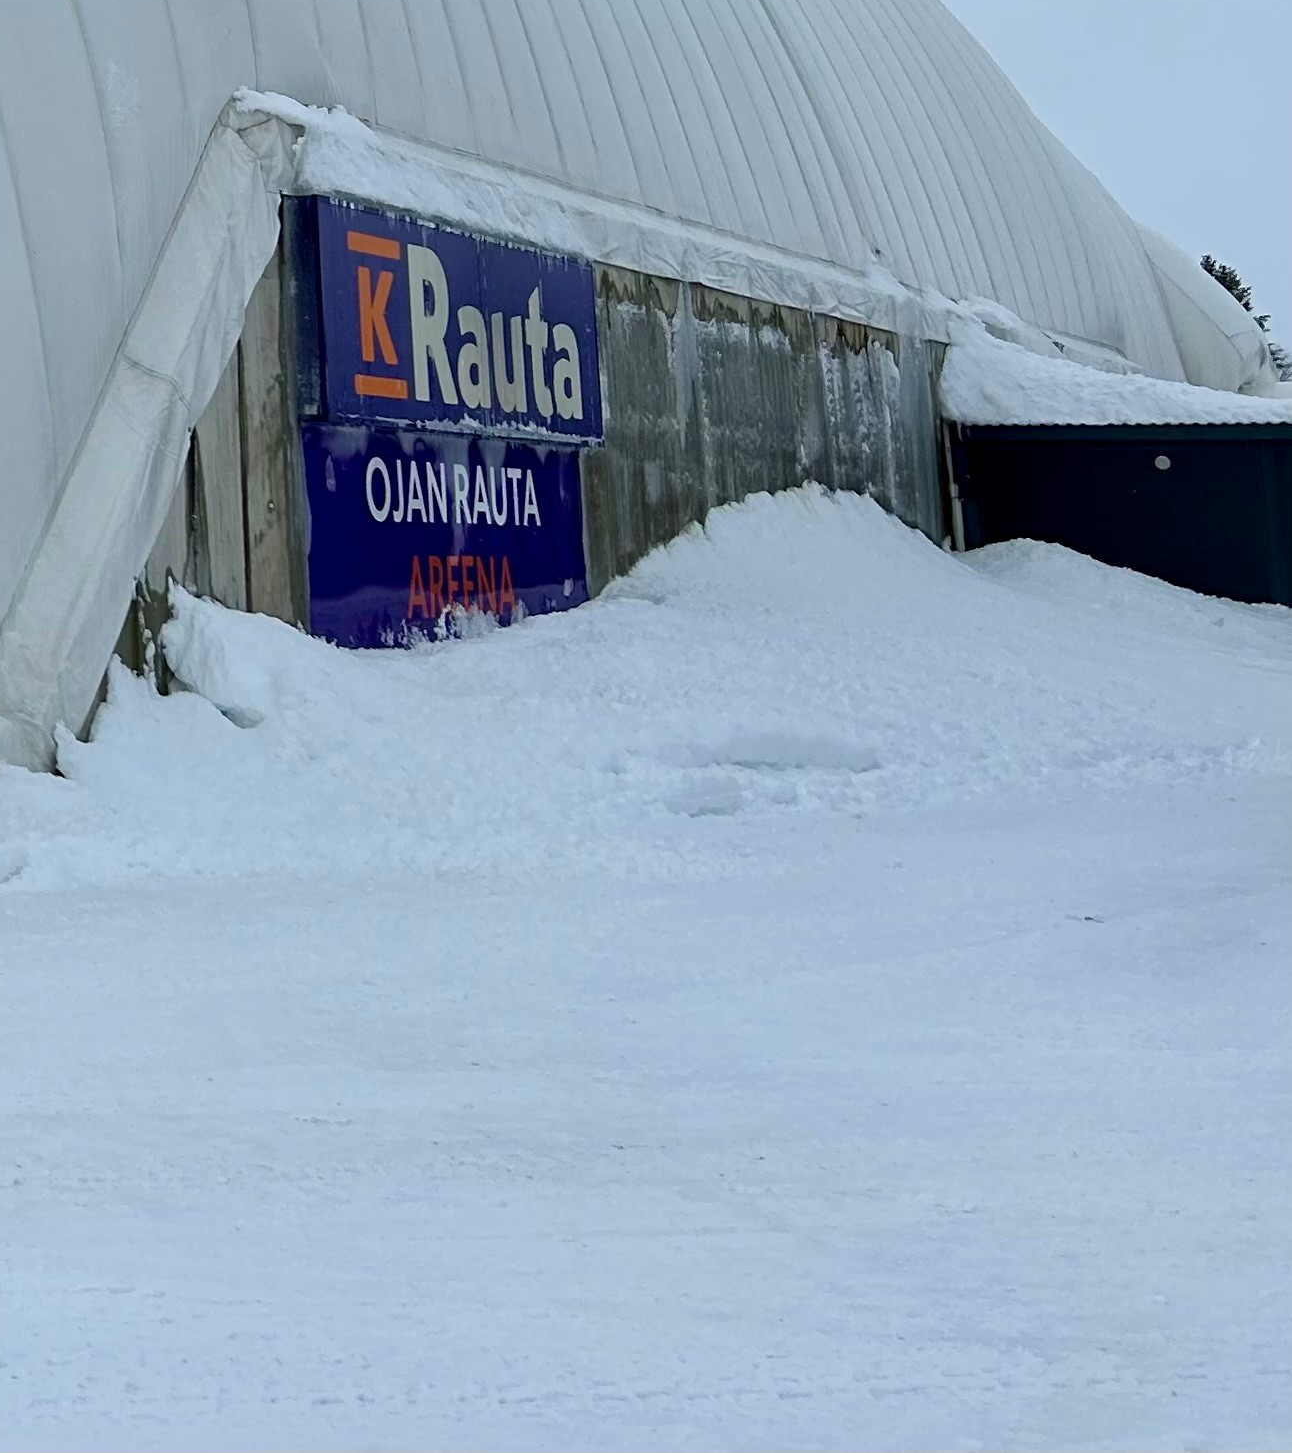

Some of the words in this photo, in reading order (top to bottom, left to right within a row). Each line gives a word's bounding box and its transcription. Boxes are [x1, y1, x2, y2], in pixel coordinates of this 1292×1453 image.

[407, 243, 583, 420] Rauta
[365, 456, 448, 524] OJAN
[455, 463, 541, 526] RAUTA
